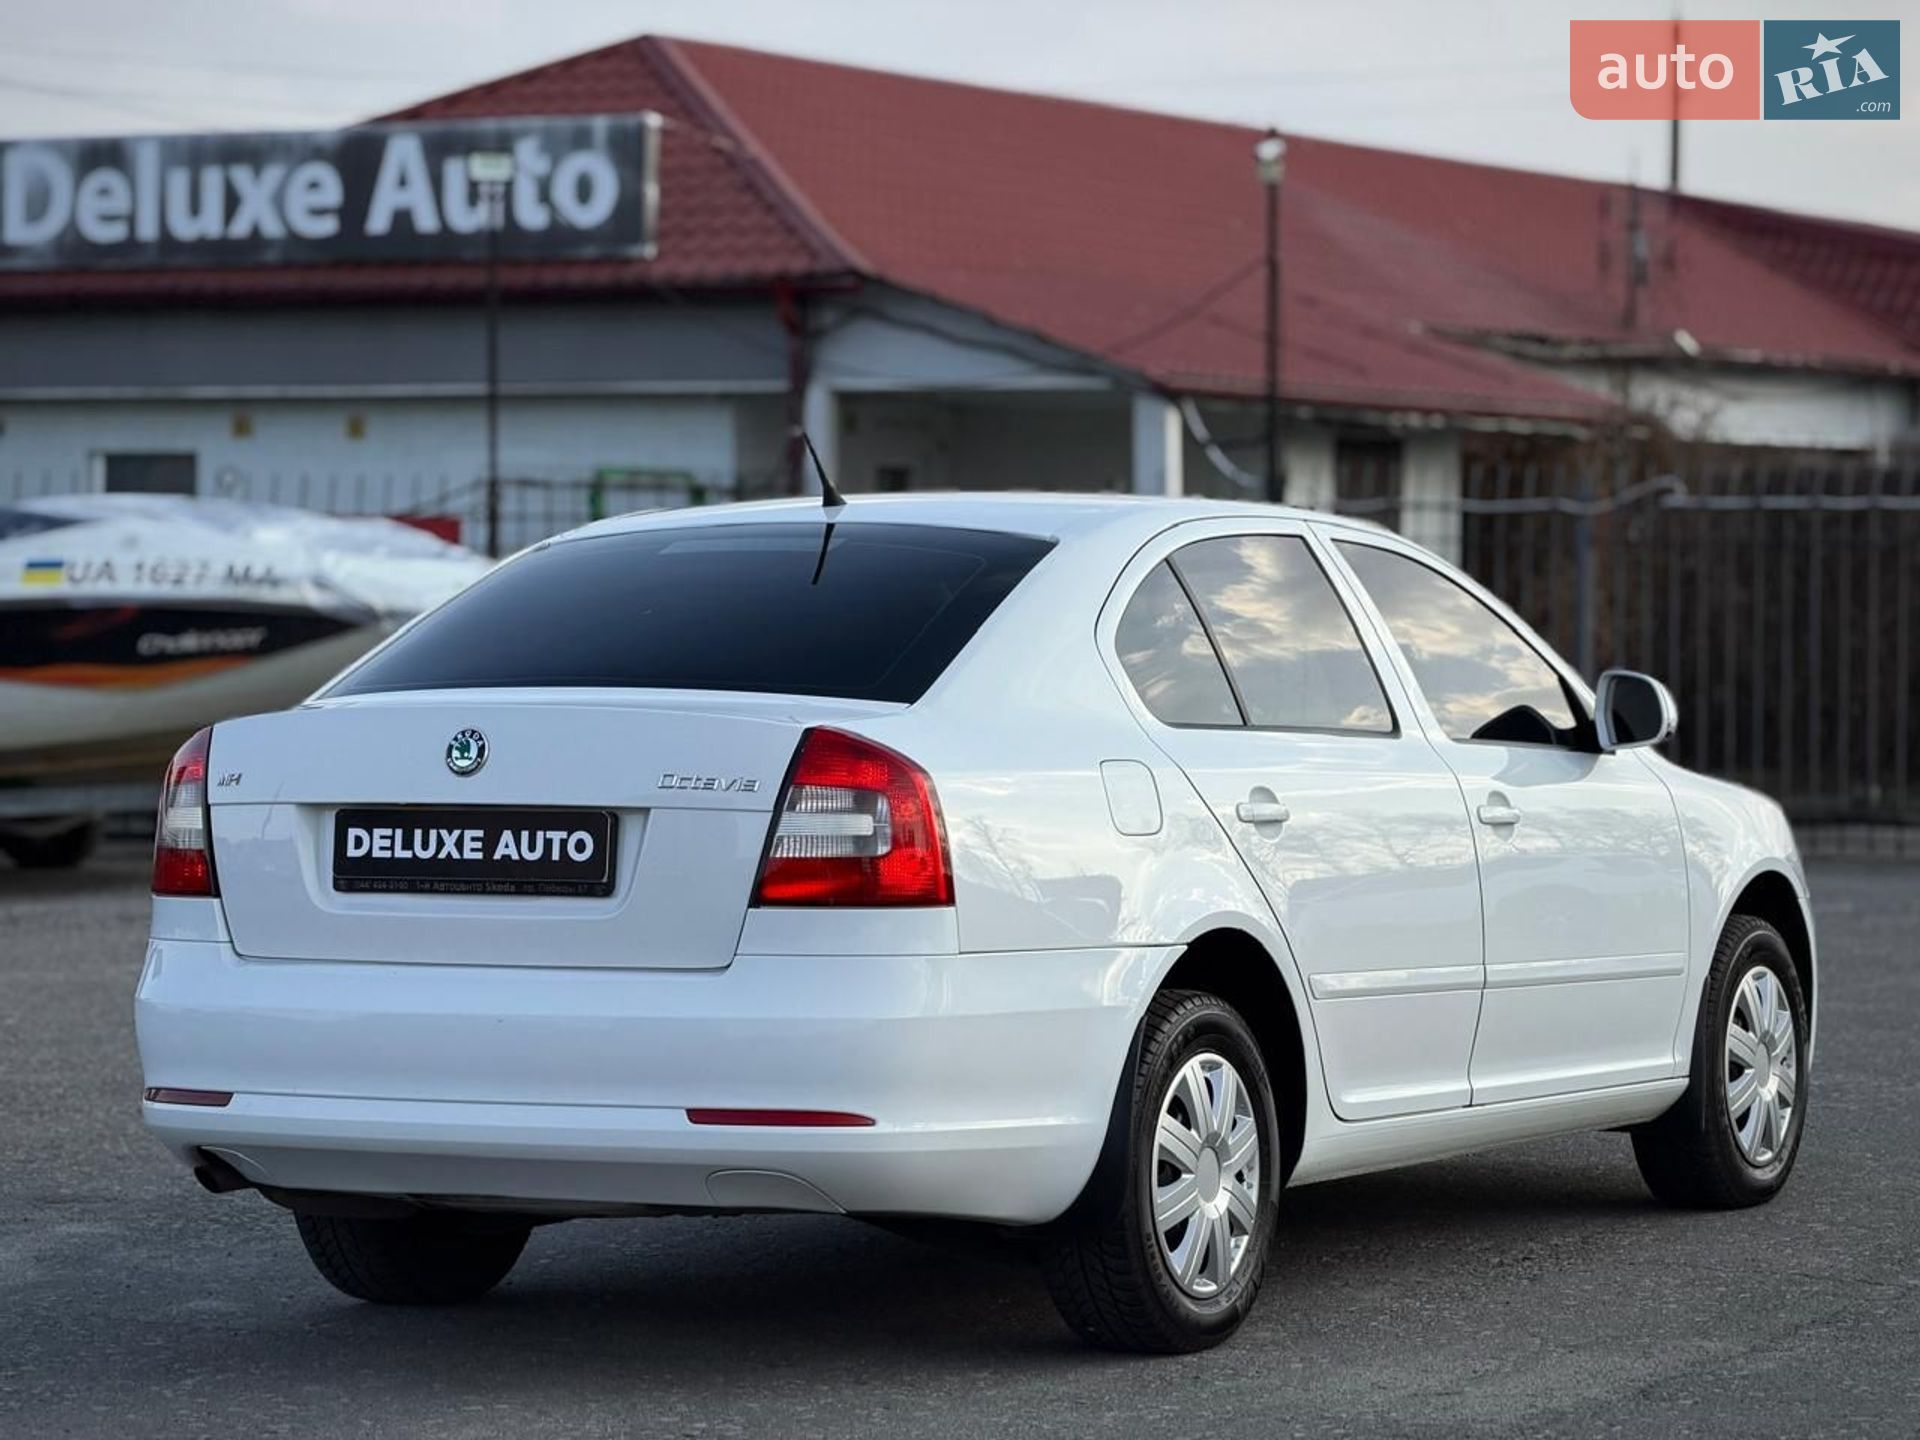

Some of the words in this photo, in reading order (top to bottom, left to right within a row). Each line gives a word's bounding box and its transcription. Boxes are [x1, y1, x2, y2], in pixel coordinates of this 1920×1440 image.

[2, 138, 342, 246] Deluxe
[365, 131, 621, 236] Auto
[67, 560, 114, 584] UA
[657, 772, 761, 793] Octavia
[346, 827, 484, 860] DELUXE
[492, 830, 595, 863] AUTO
